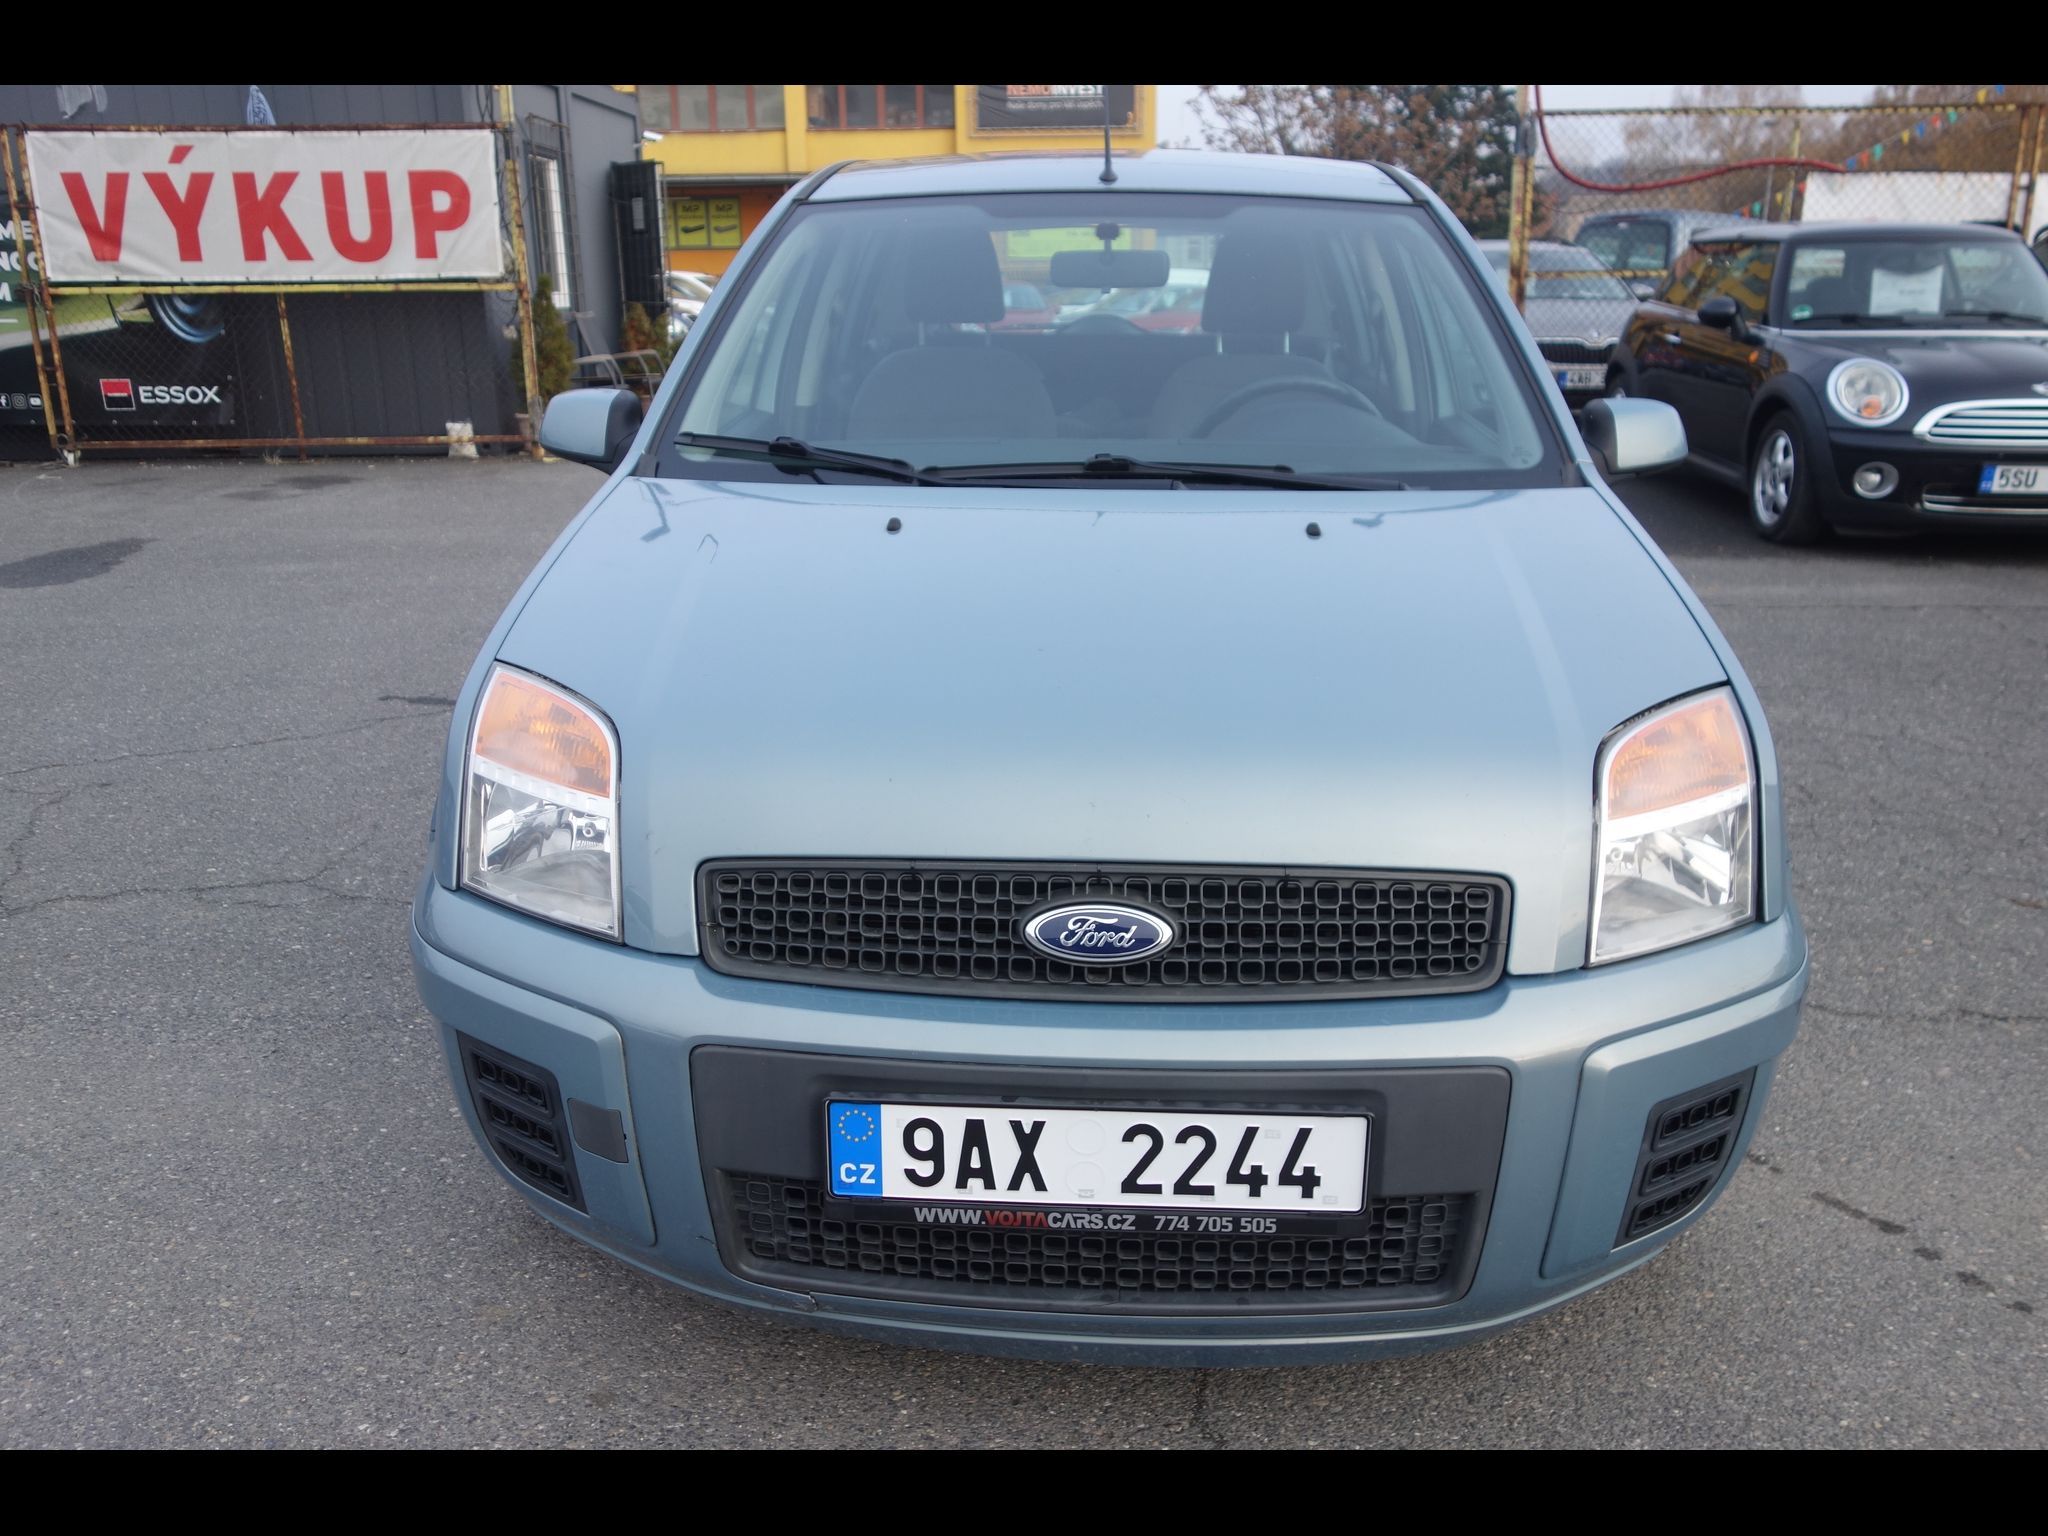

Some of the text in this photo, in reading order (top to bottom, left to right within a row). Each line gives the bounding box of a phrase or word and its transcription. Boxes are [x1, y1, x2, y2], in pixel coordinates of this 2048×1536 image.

[61, 145, 471, 262] VÝKUP
[138, 385, 222, 404] ESSOX
[1999, 468, 2039, 488] 5SU
[1060, 915, 1138, 948] Ford
[903, 1117, 1322, 1199] 9AX 2244
[839, 1162, 876, 1184] CZ
[914, 1207, 1277, 1233] WWW.VOJTACARS.CZ 774 705 505
